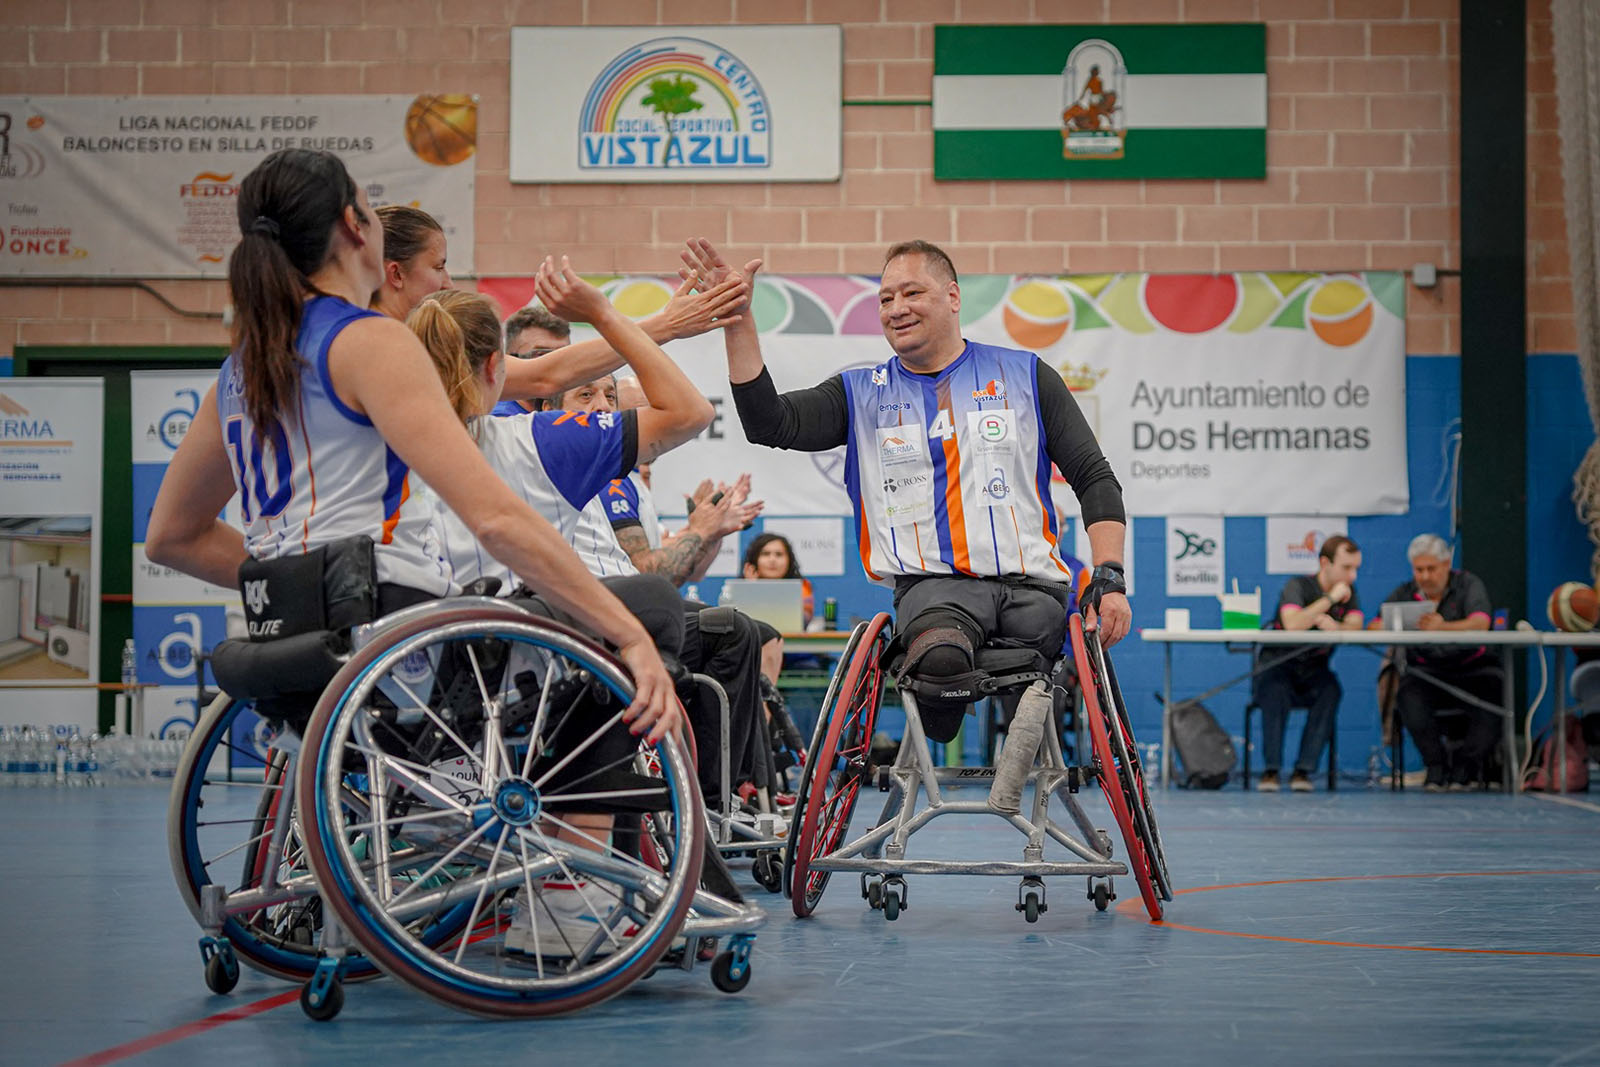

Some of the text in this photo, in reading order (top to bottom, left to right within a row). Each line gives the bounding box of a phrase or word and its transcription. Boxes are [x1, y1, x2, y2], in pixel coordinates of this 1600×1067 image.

[713, 53, 767, 133] CENTRO
[119, 116, 159, 131] LIGA
[164, 116, 256, 131] NACIONAL
[616, 119, 732, 132] SOCIAL-EPORTIVO
[63, 137, 374, 151] BALONCESTO EN SILLA DE RUEDAS
[584, 136, 766, 165] VISTAZUL
[180, 183, 241, 197] FEDD
[10, 239, 70, 255] ONCE
[1131, 380, 1370, 414] Ayuntamiento de
[0, 420, 54, 437] RMA
[928, 409, 955, 440] 4
[1133, 421, 1371, 450] Dos Hermanas
[226, 413, 297, 526] 10
[1131, 461, 1211, 479] Deportes
[896, 475, 928, 488] CROSS
[959, 769, 998, 777] TOP EN
